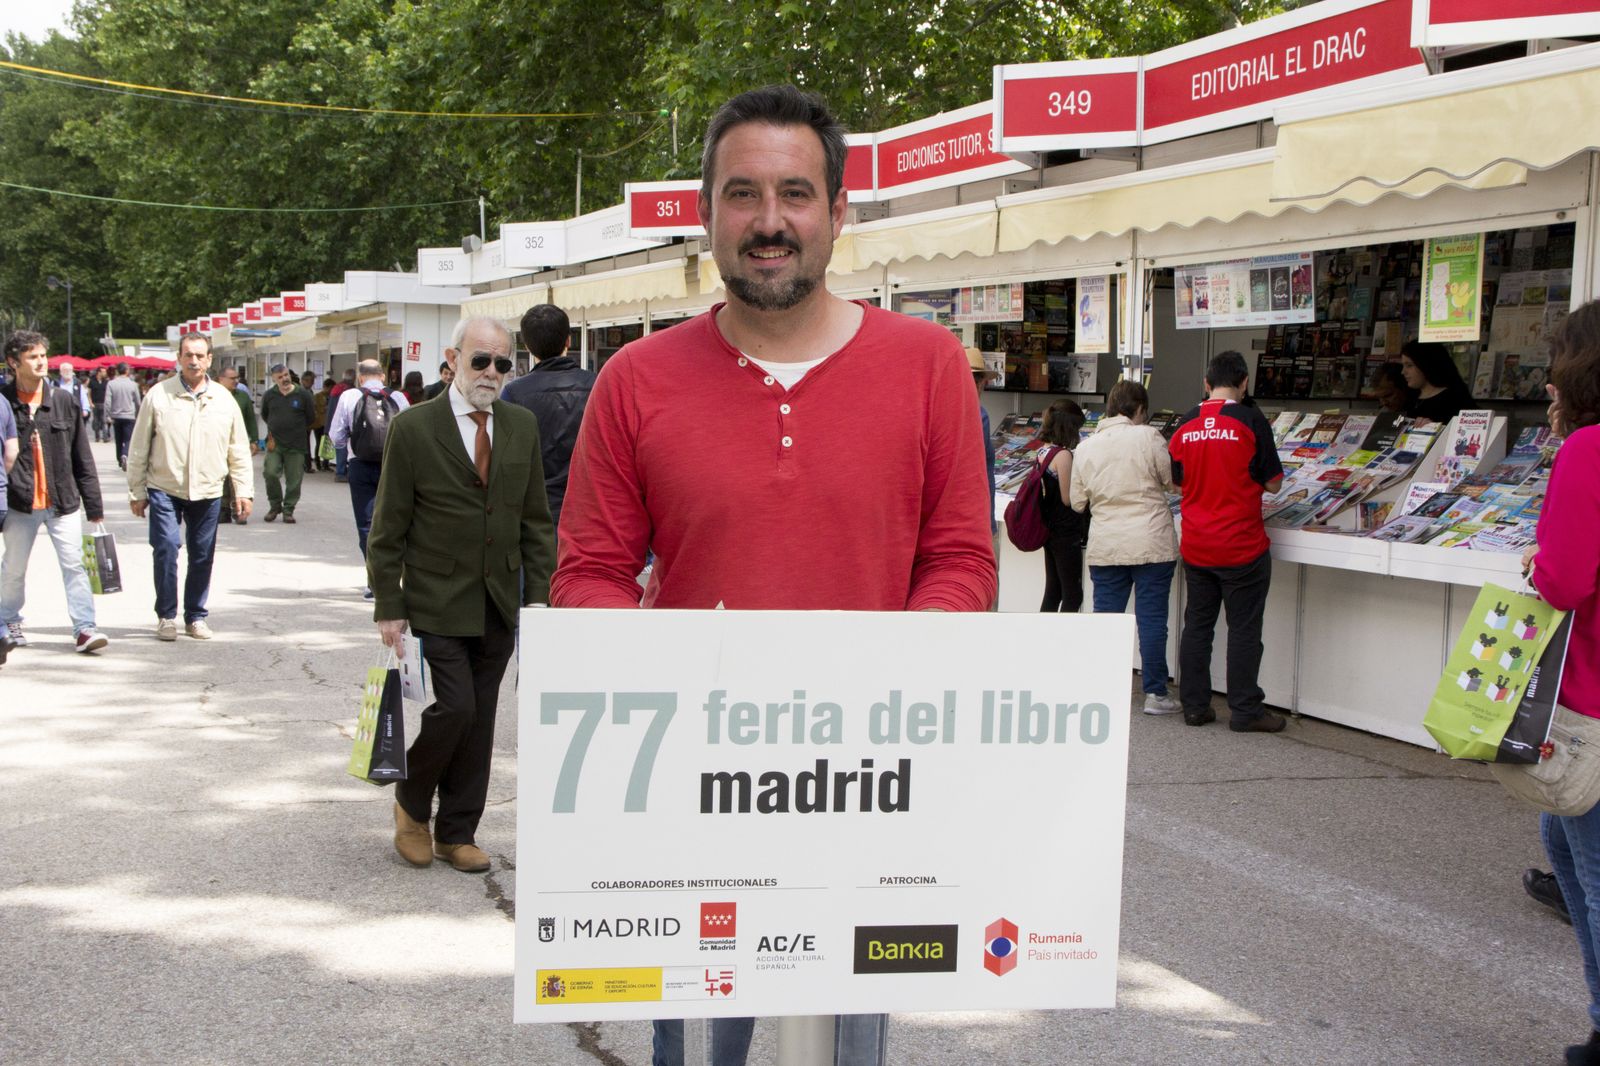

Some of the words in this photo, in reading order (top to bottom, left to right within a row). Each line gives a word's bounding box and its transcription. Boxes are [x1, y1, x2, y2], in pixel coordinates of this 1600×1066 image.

[1191, 51, 1279, 101] EDITORIAL
[1285, 46, 1307, 75] EL
[1313, 27, 1367, 69] DRAC
[1048, 90, 1092, 118] 349
[898, 141, 946, 173] EDICIONES
[948, 132, 985, 157] TUTOR,
[657, 200, 680, 217] 351
[524, 235, 544, 249] 352
[438, 260, 454, 272] 353
[293, 299, 305, 308] 355
[1182, 429, 1239, 443] FIDUCIAL
[703, 689, 844, 745] feria
[868, 690, 955, 745] del
[980, 690, 1111, 745] libro
[539, 691, 679, 814] 77
[700, 758, 912, 814] madrid
[591, 880, 685, 890] COLABORADORES
[687, 878, 778, 888] INSTITUCIONALES
[879, 876, 937, 885] PATROCINA
[573, 917, 681, 938] MADRID
[756, 933, 816, 953] AC/E
[1028, 931, 1083, 944] Rumanía
[868, 939, 944, 961] Bankia
[1053, 948, 1098, 961] invitado
[756, 955, 785, 963] ACCIÓN
[787, 954, 826, 962] CULTURAL
[756, 963, 796, 971] ESPAÑOLA
